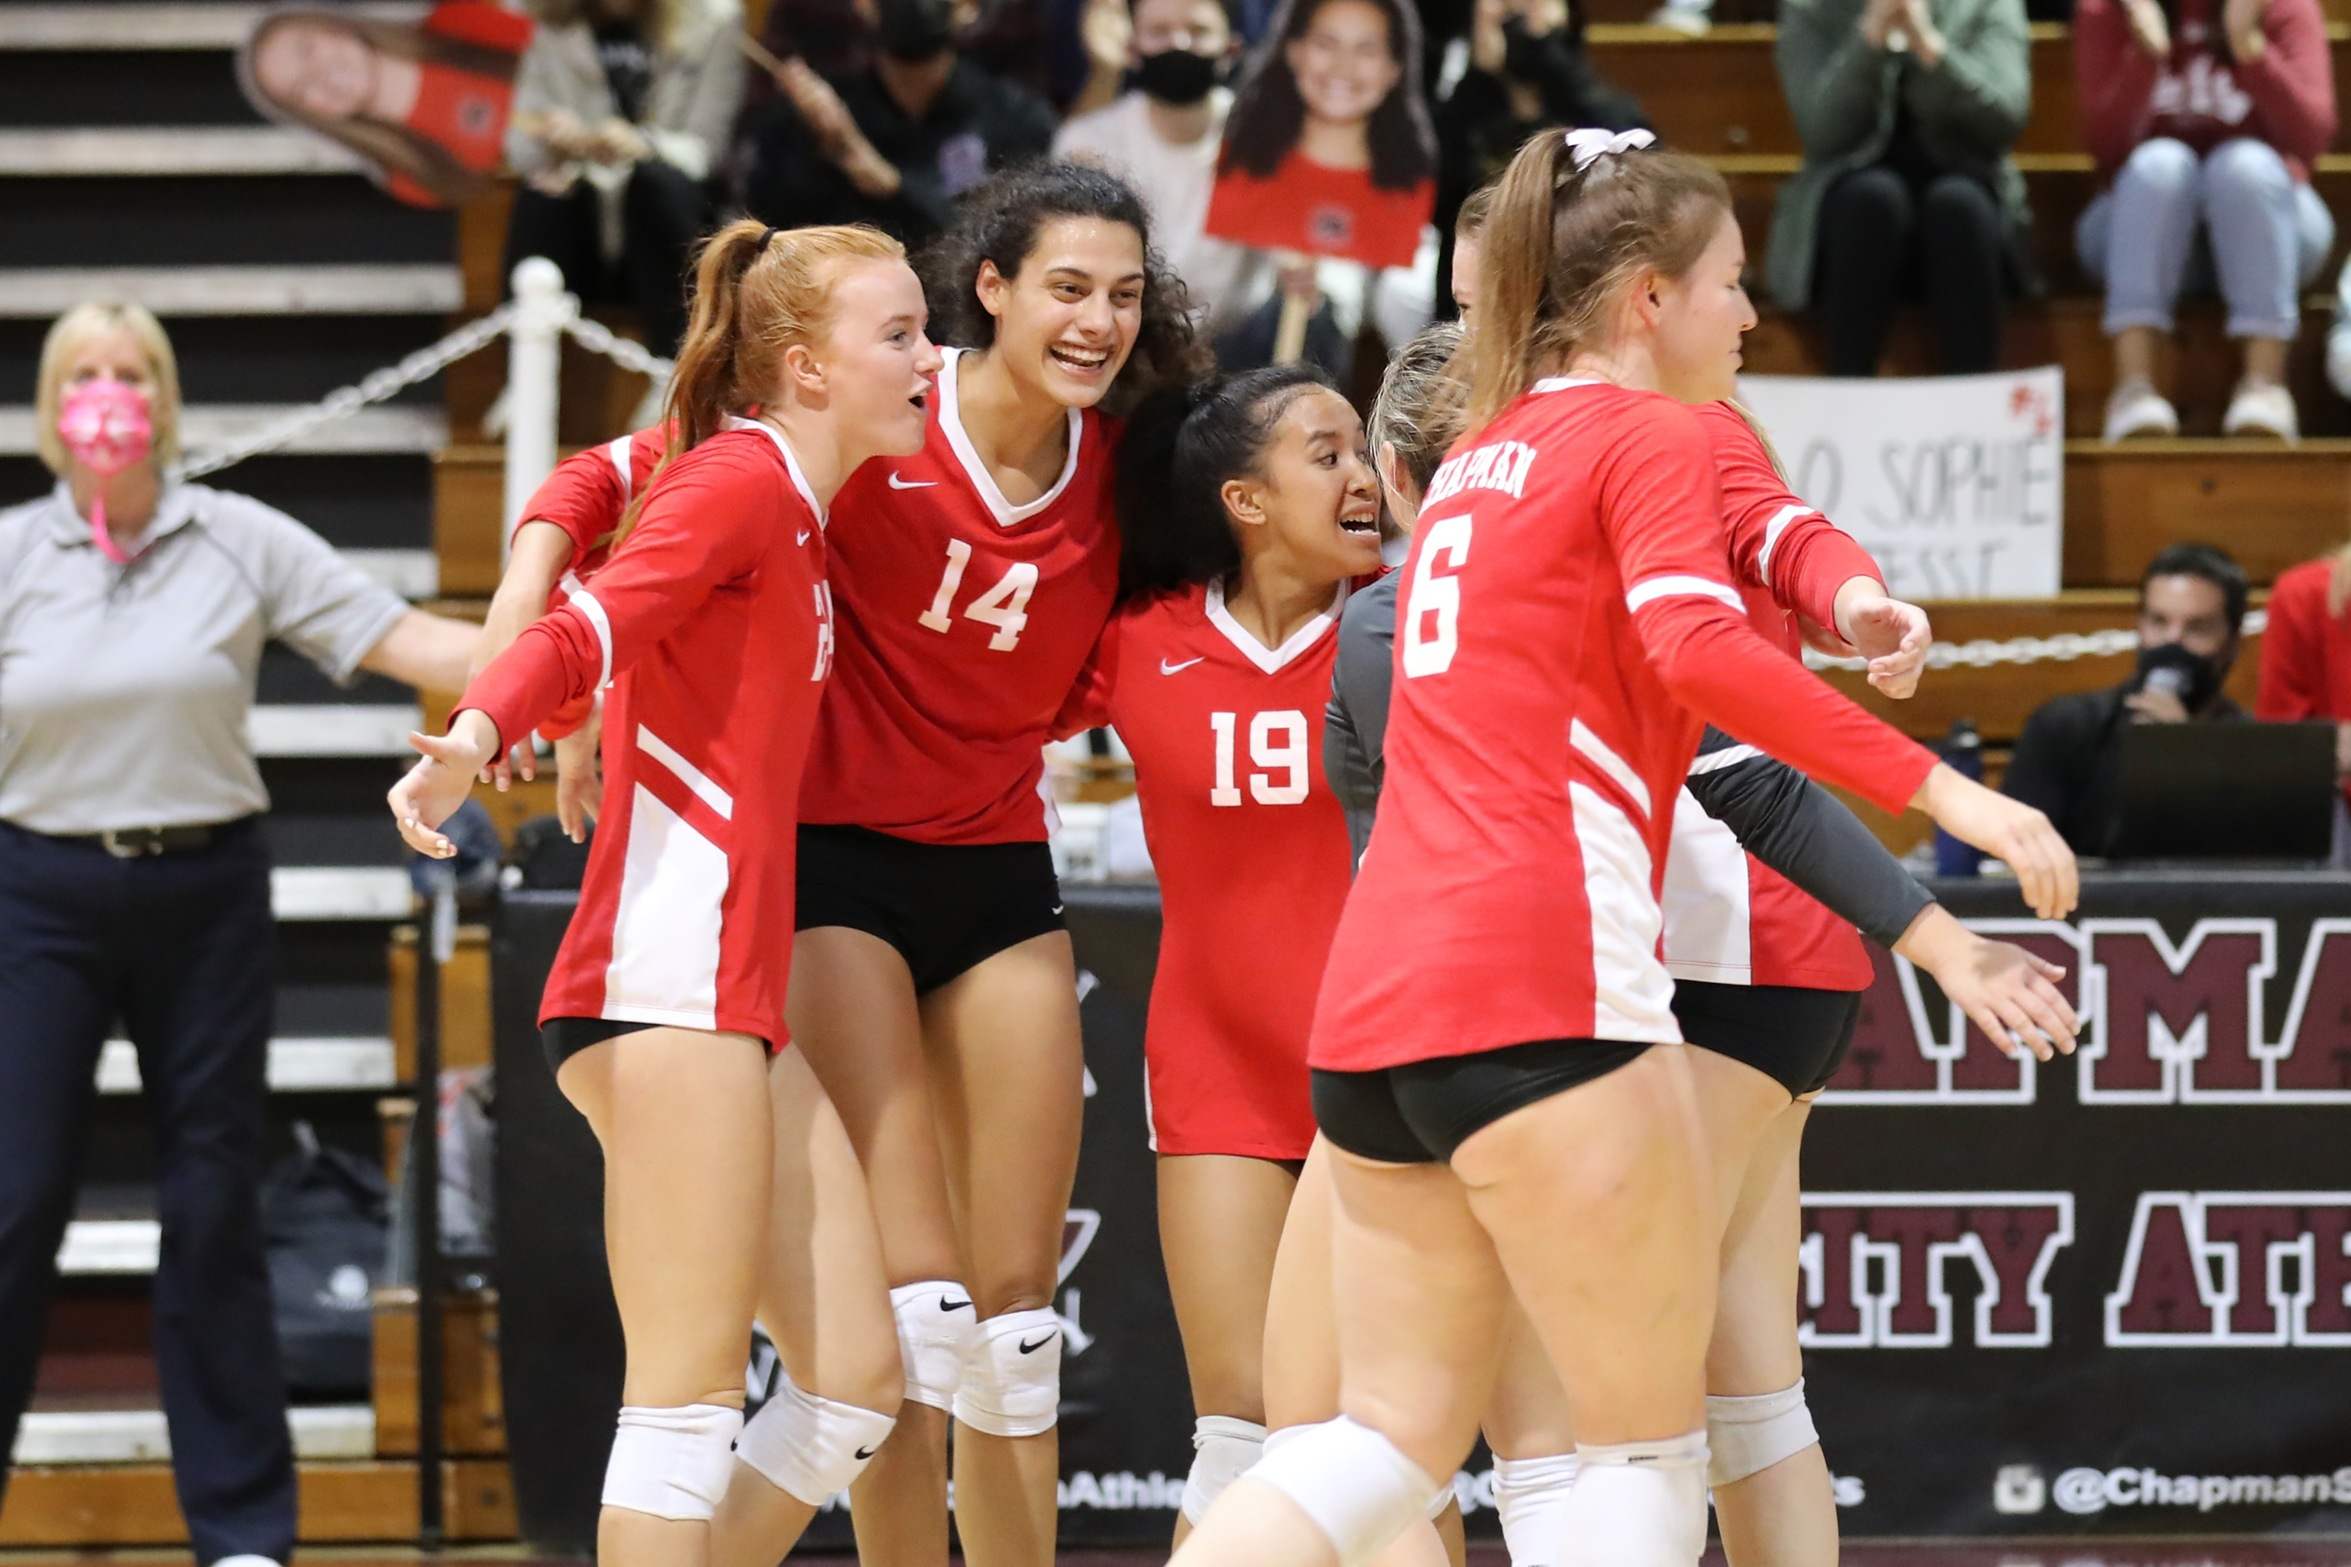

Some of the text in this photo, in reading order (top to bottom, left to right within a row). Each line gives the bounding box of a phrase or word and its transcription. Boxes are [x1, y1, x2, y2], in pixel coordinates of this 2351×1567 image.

[1862, 434, 2053, 530] SOPHIE
[917, 537, 1040, 652] 14
[1403, 514, 1473, 679] 6
[1210, 709, 1310, 807] 19
[1799, 1191, 2075, 1347] ITY
